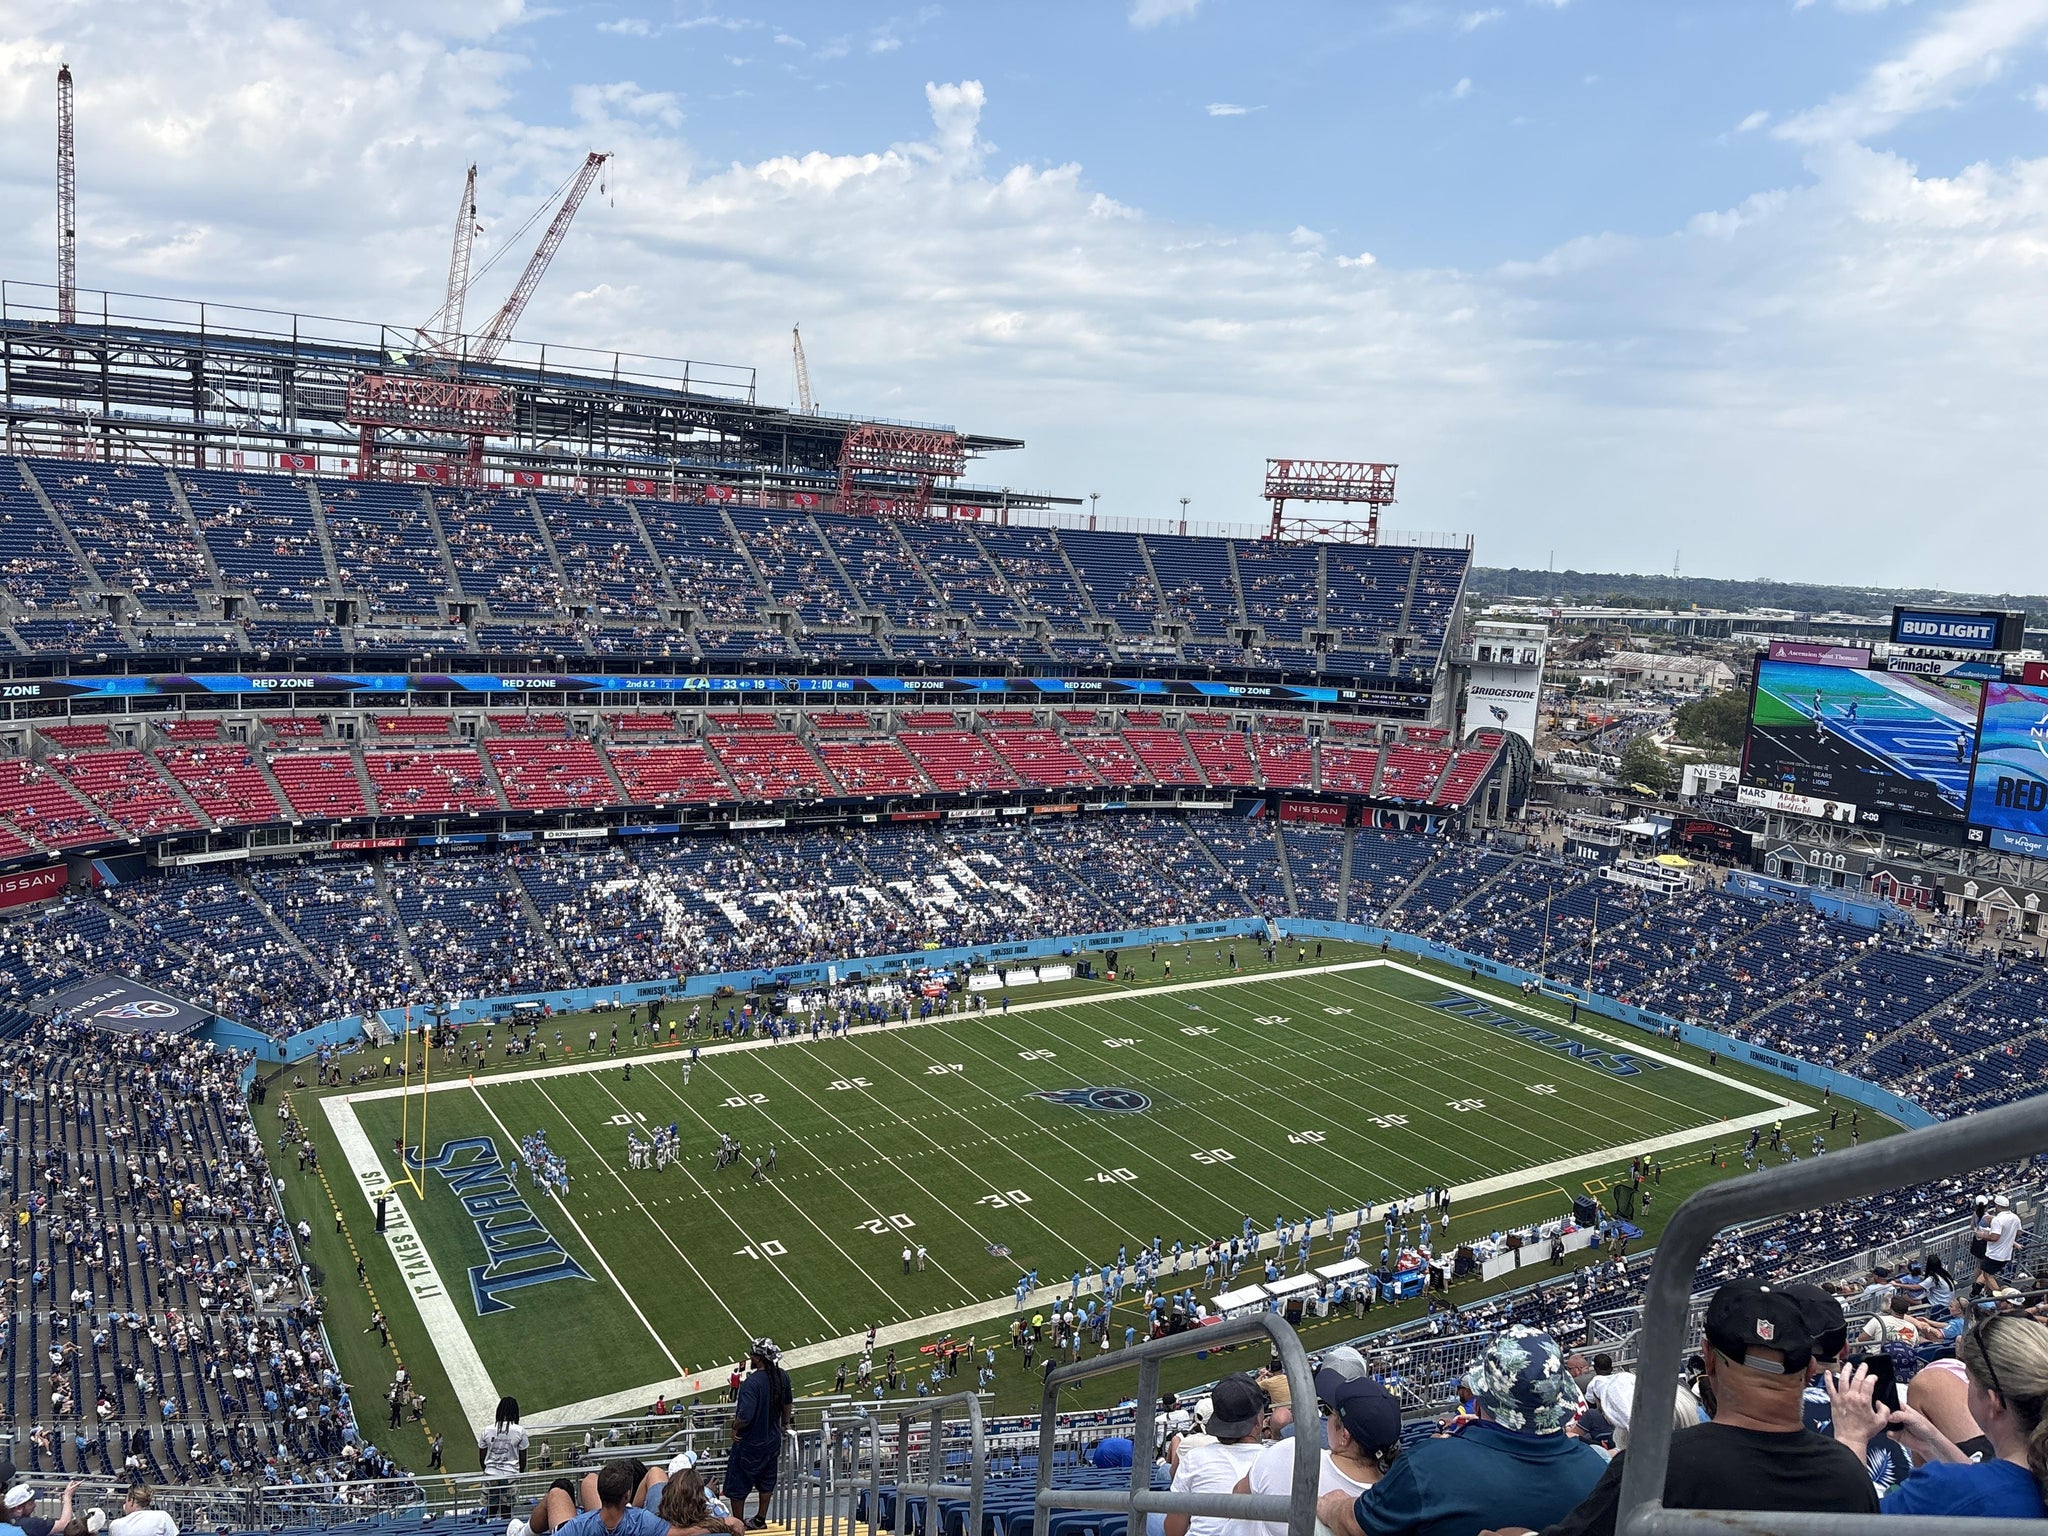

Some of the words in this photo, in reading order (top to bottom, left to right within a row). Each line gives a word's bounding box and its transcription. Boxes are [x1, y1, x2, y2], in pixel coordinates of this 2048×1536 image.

[1902, 620, 1938, 635] BUD
[1939, 624, 1991, 640] LIGHT
[1788, 649, 1818, 658] Ascension
[1819, 652, 1834, 660] Saint
[1834, 653, 1859, 662] Thomas
[1889, 656, 1942, 675] Pinnacle
[1953, 669, 2000, 681] TitansBanking.com
[252, 678, 278, 689] RED
[279, 678, 314, 688] ZONE
[502, 679, 524, 688] RED
[526, 679, 556, 688] ZONE
[723, 679, 737, 689] 33
[754, 679, 765, 689] 19
[811, 679, 833, 690] 2:00
[837, 681, 849, 689] 4th
[903, 681, 921, 689] RED
[922, 681, 945, 689] ZONE
[1064, 681, 1079, 689] RED
[1080, 681, 1102, 689] ZONE
[3, 684, 40, 697] ZONE
[1229, 687, 1246, 695] RED
[1247, 688, 1271, 696] ZONE
[1470, 685, 1537, 699] BRIDGESTONE
[1694, 768, 1738, 782] NISSA
[1813, 771, 1833, 780] BEARS
[1812, 778, 1830, 787] LIONS
[1740, 787, 1767, 799] MARS
[1995, 776, 2048, 813] RED
[1289, 805, 1338, 815] NISSAN
[1862, 811, 1879, 822] 2:00
[2015, 836, 2042, 852] Kroger
[272, 853, 299, 861] HONOR
[314, 852, 341, 860] ADAMS
[1577, 846, 1599, 860] lite
[0, 873, 56, 893] ISSAN
[637, 985, 667, 997] TENNESSEE
[71, 988, 126, 1014] NISSAN
[491, 1001, 514, 1013] TENNES
[1254, 1015, 1286, 1025] 20
[179, 1020, 205, 1037] NISSAN
[1179, 1025, 1216, 1036] 30
[1425, 991, 1667, 1077] TITANS
[1581, 1026, 1623, 1043] LOVE
[1101, 1037, 1135, 1048] 40
[1018, 1049, 1057, 1061] 50
[1750, 1050, 1779, 1070] TENNESSEE
[928, 1063, 964, 1075] 40
[831, 1077, 873, 1091] 30
[729, 1093, 770, 1108] 20
[1446, 1099, 1484, 1112] 20
[610, 1111, 648, 1126] 10
[1367, 1114, 1407, 1128] 30
[1287, 1130, 1323, 1145] 40
[1191, 1148, 1237, 1164] 50
[360, 1171, 386, 1187] US
[1096, 1167, 1139, 1184] 40
[983, 1189, 1033, 1209] 30
[393, 1136, 598, 1316] TITANS
[863, 1212, 916, 1235] 20
[743, 1239, 788, 1260] 10
[391, 1234, 432, 1280] TAKES
[414, 1284, 442, 1300] IT
[1112, 1415, 1136, 1424] permo
